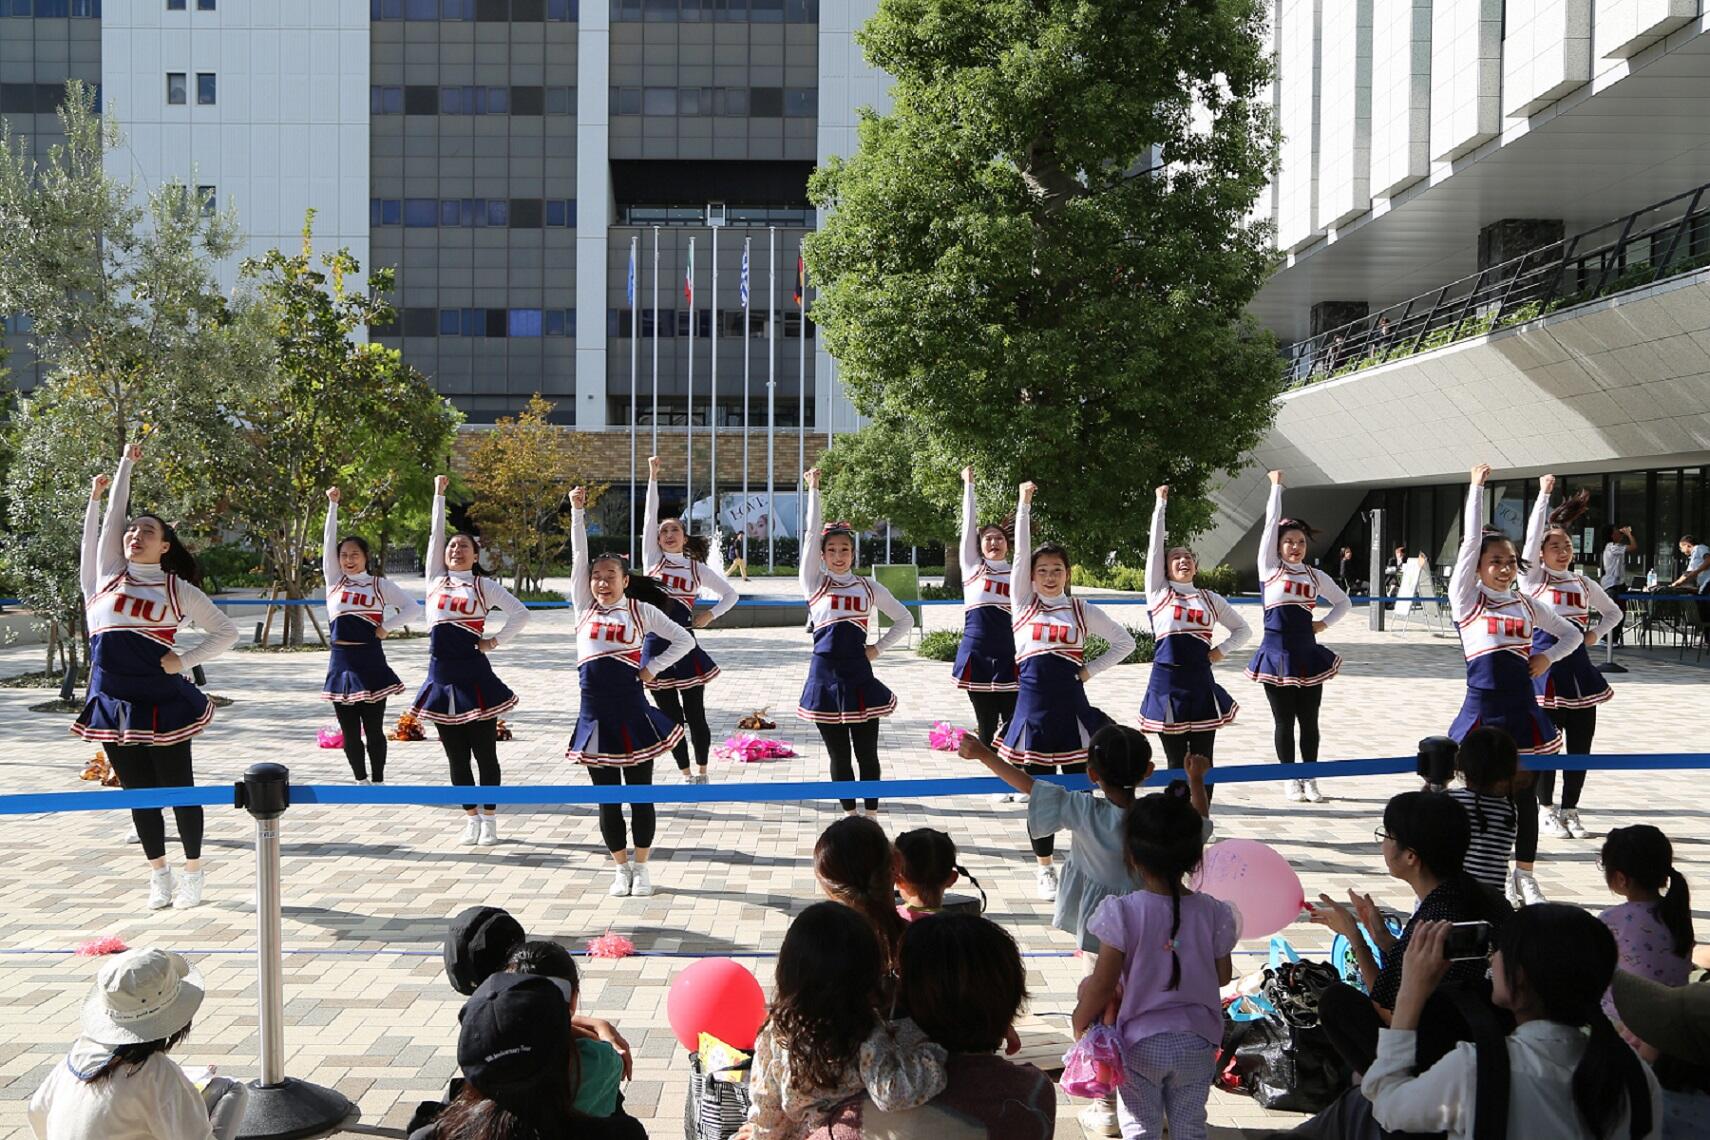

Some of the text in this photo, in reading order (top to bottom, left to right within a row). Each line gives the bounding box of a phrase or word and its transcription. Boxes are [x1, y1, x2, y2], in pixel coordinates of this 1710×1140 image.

[660, 573, 694, 592] TIU
[1282, 579, 1317, 599] TIU
[114, 593, 167, 622] TIU
[340, 591, 376, 608] TIU
[437, 594, 477, 615] TIU
[826, 594, 868, 612] TIU
[1548, 587, 1587, 609] TIU
[1171, 604, 1211, 626] TIU
[589, 621, 636, 644] TIU
[1030, 622, 1079, 644] TIU
[1481, 616, 1533, 639] TIU
